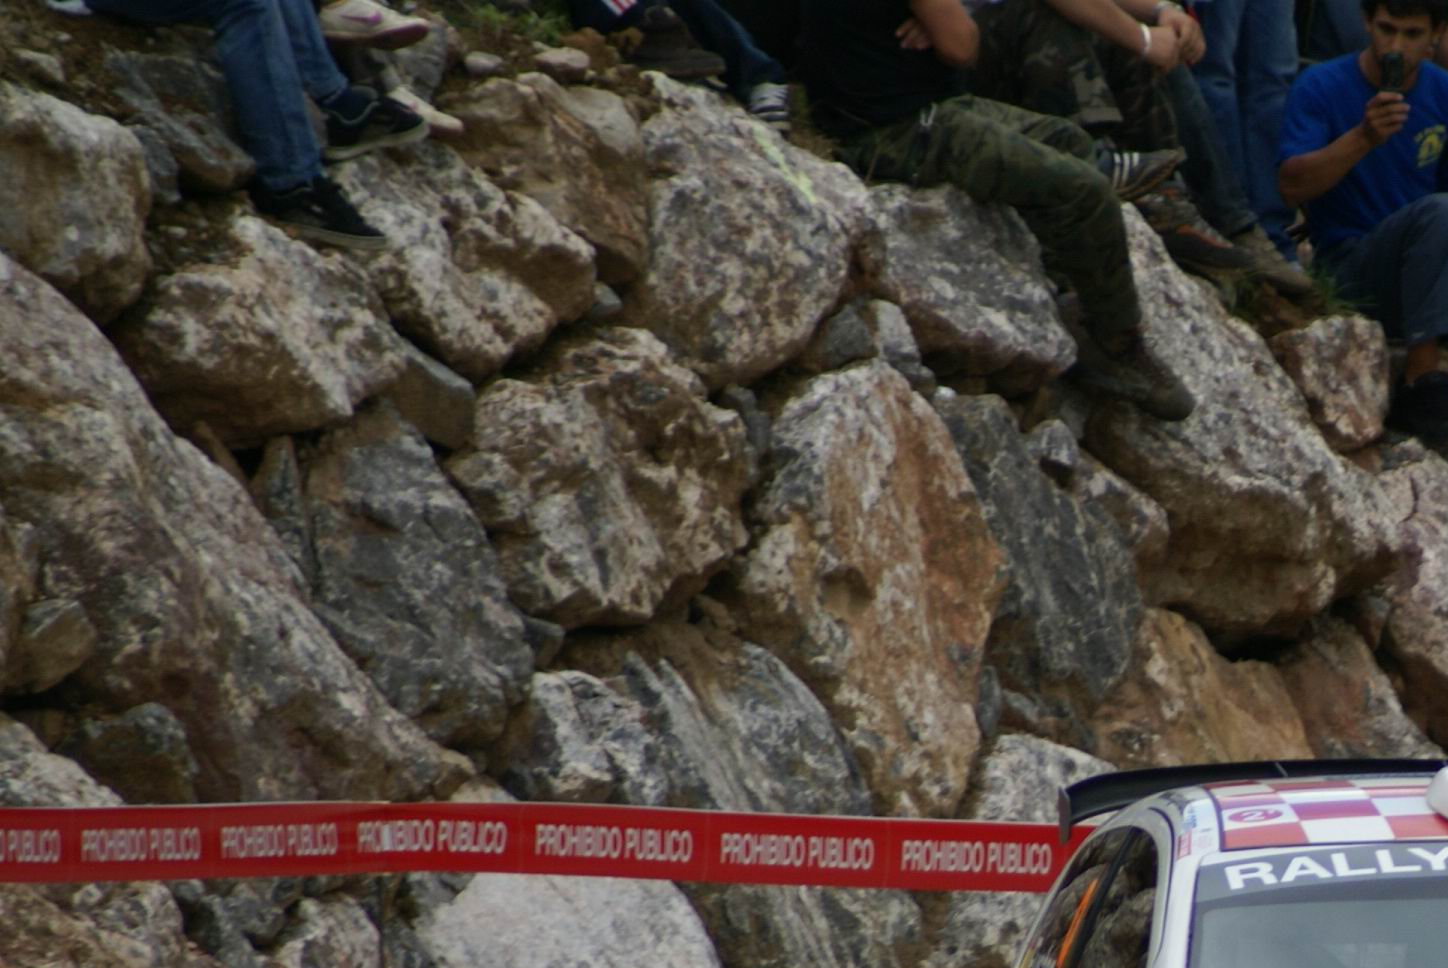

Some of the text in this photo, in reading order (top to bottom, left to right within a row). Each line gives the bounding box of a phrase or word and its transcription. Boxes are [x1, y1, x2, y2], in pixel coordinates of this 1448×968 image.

[7, 829, 61, 862] PUBLICO
[81, 827, 200, 863] PROHIBIDO PUBLICO
[221, 822, 338, 859] PROHIBIDO PUBLICO
[437, 820, 507, 854] PUBLICO
[534, 823, 693, 864] PROHIBIDO PUBLICO
[720, 832, 874, 871] PROHIBIDO PUBLICO
[901, 839, 1052, 876] PROHIBIDO PUBLICO
